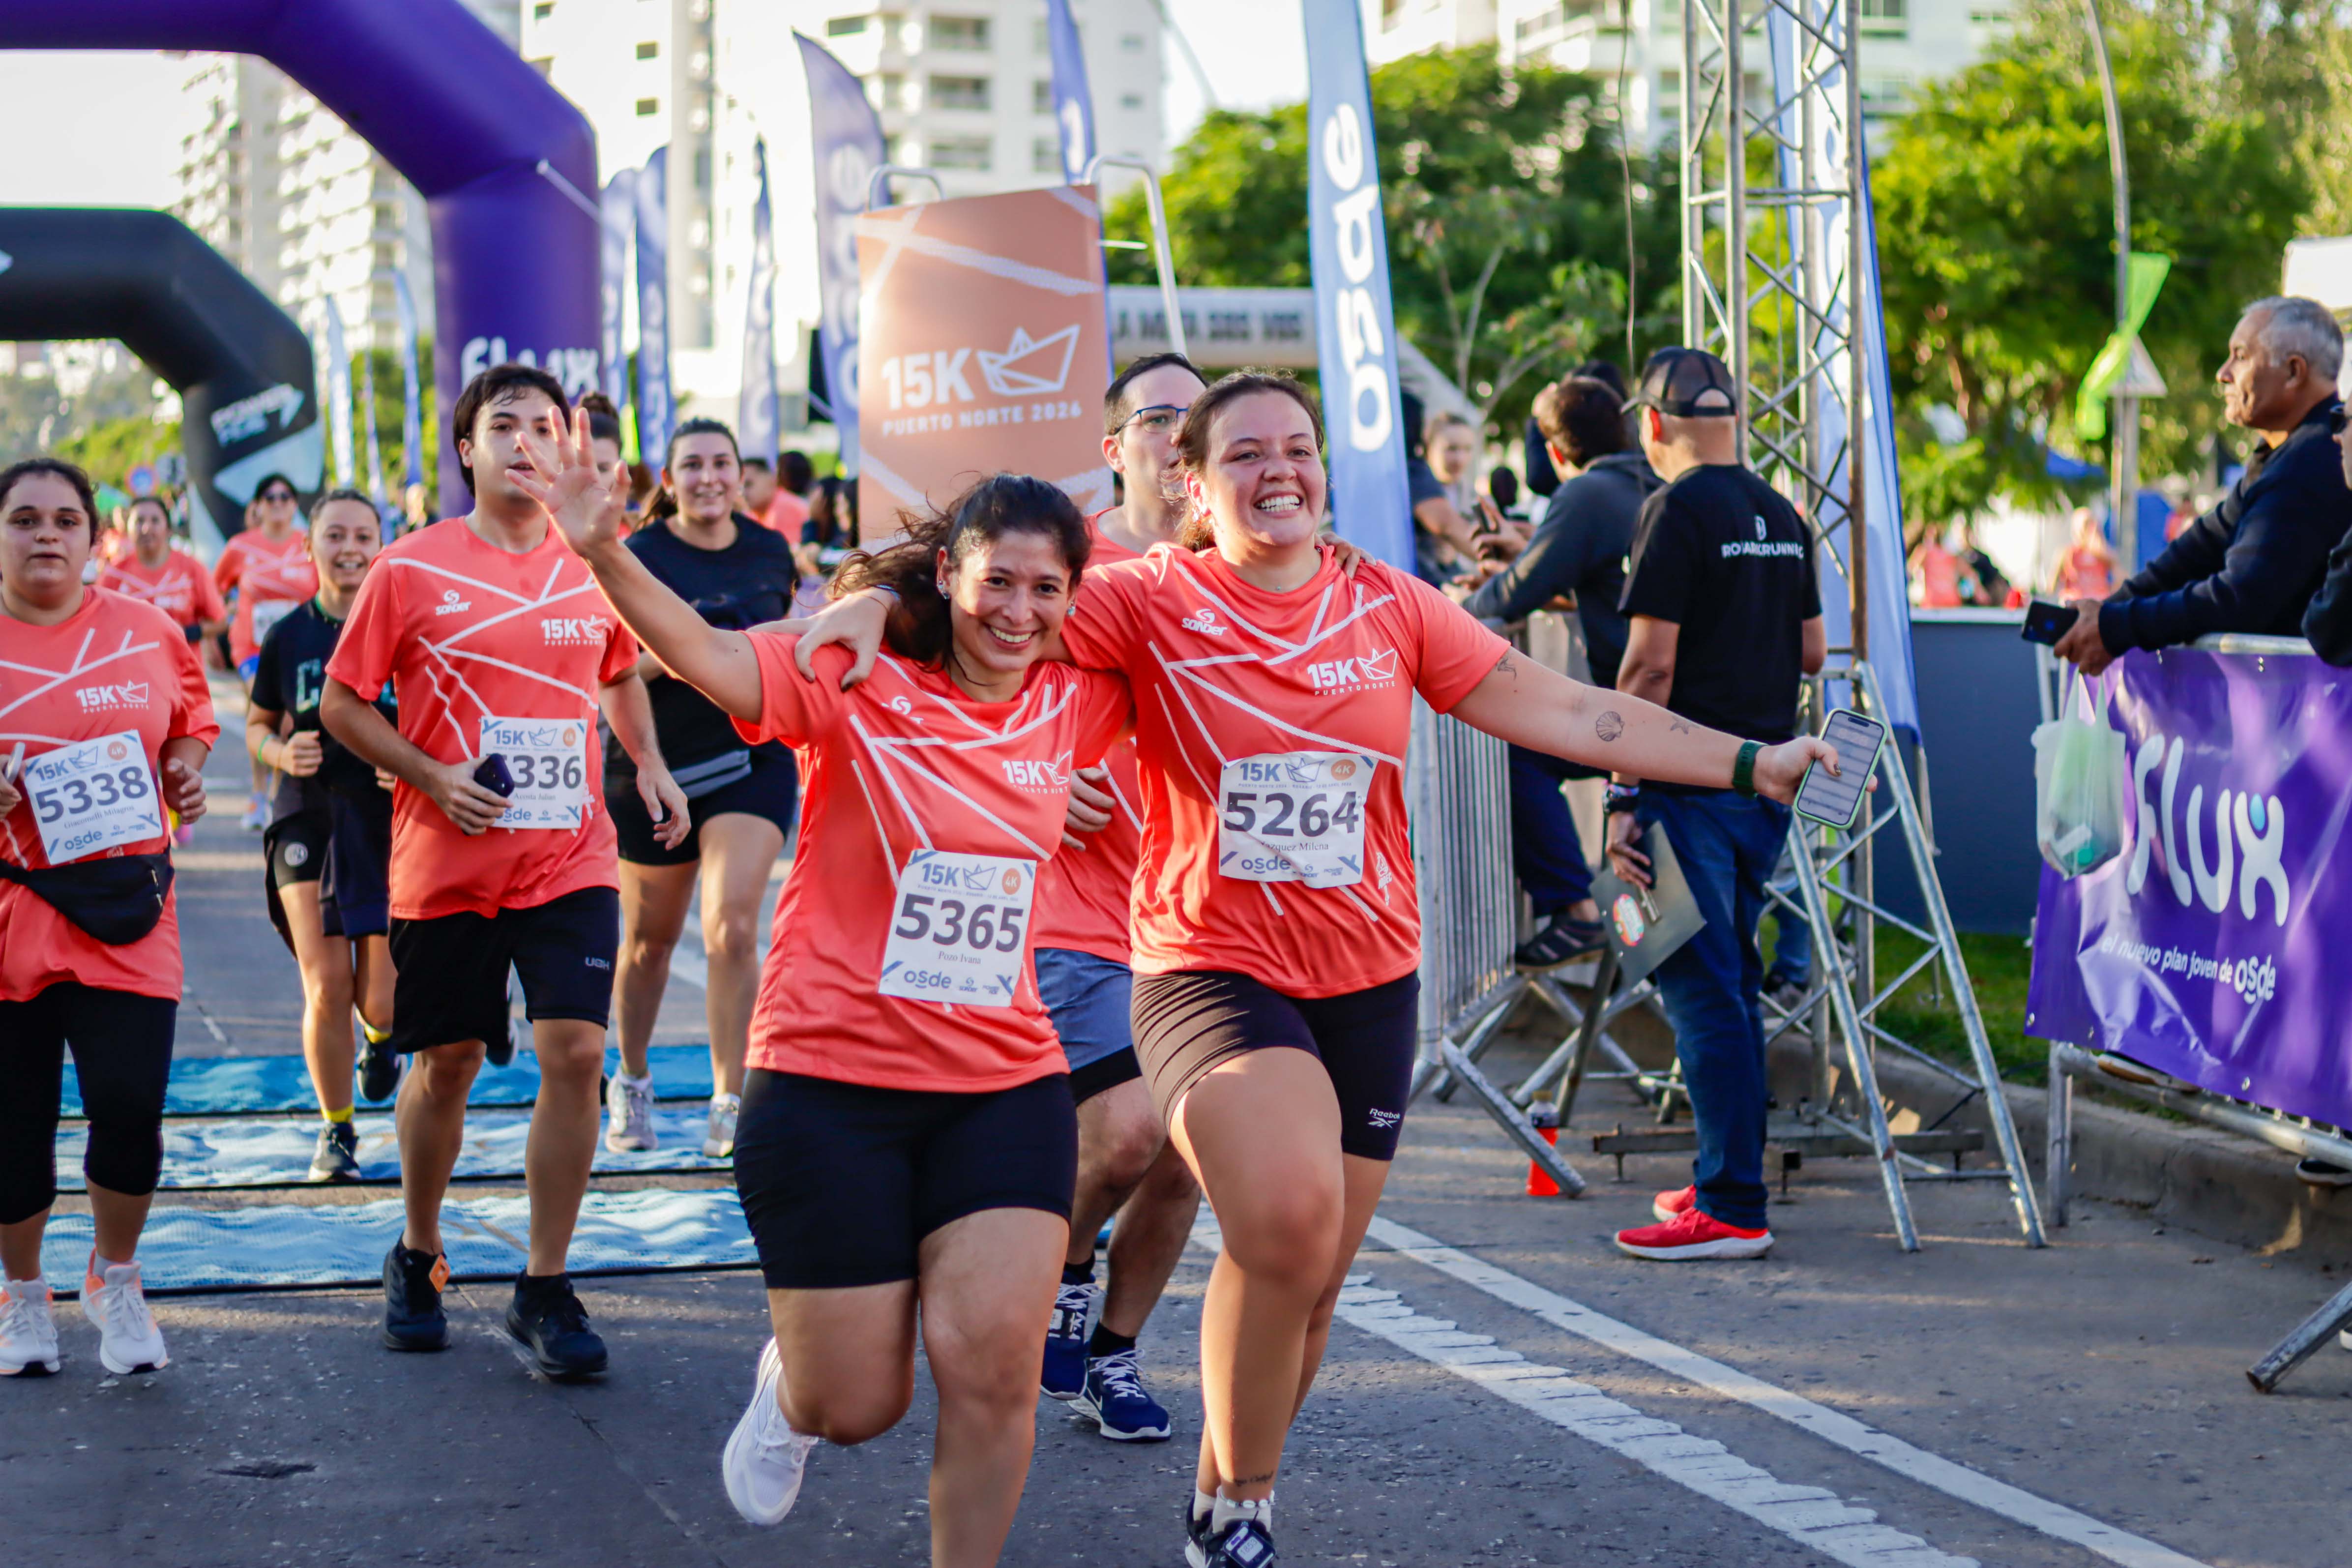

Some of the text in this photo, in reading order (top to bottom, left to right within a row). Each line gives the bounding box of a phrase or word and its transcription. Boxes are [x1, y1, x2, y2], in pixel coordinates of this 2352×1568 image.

[1322, 103, 1392, 452] osde
[881, 348, 975, 411] 15K
[882, 401, 1082, 437] PUERTO NORTE 2026
[541, 618, 580, 639] 15K
[1307, 658, 1360, 688] 15K
[76, 685, 118, 708] 15K
[1315, 680, 1395, 696] PUERTO NORTE
[494, 729, 525, 745] 15K
[111, 746, 124, 756] 4K
[36, 759, 70, 781] 15K
[486, 753, 582, 789] 336
[1002, 760, 1046, 785] 15K
[1240, 763, 1281, 782] 15K
[1334, 765, 1352, 775] 4K
[35, 766, 148, 824] 5338
[104, 805, 135, 817] Milagros
[496, 808, 531, 822] sde
[1224, 791, 1359, 837] 5264
[64, 830, 102, 850] osde
[2127, 733, 2290, 927] flux
[1299, 842, 1329, 851] Milena
[922, 862, 960, 887] 15K
[1241, 856, 1291, 874] osde
[1005, 876, 1017, 887] 4K
[895, 893, 1024, 952] 5365
[938, 950, 981, 965] Pozo Ivana
[904, 970, 952, 989] osde
[2101, 935, 2277, 1005] el nuevo plan joven de osde
[1369, 1108, 1401, 1119] Reebok
